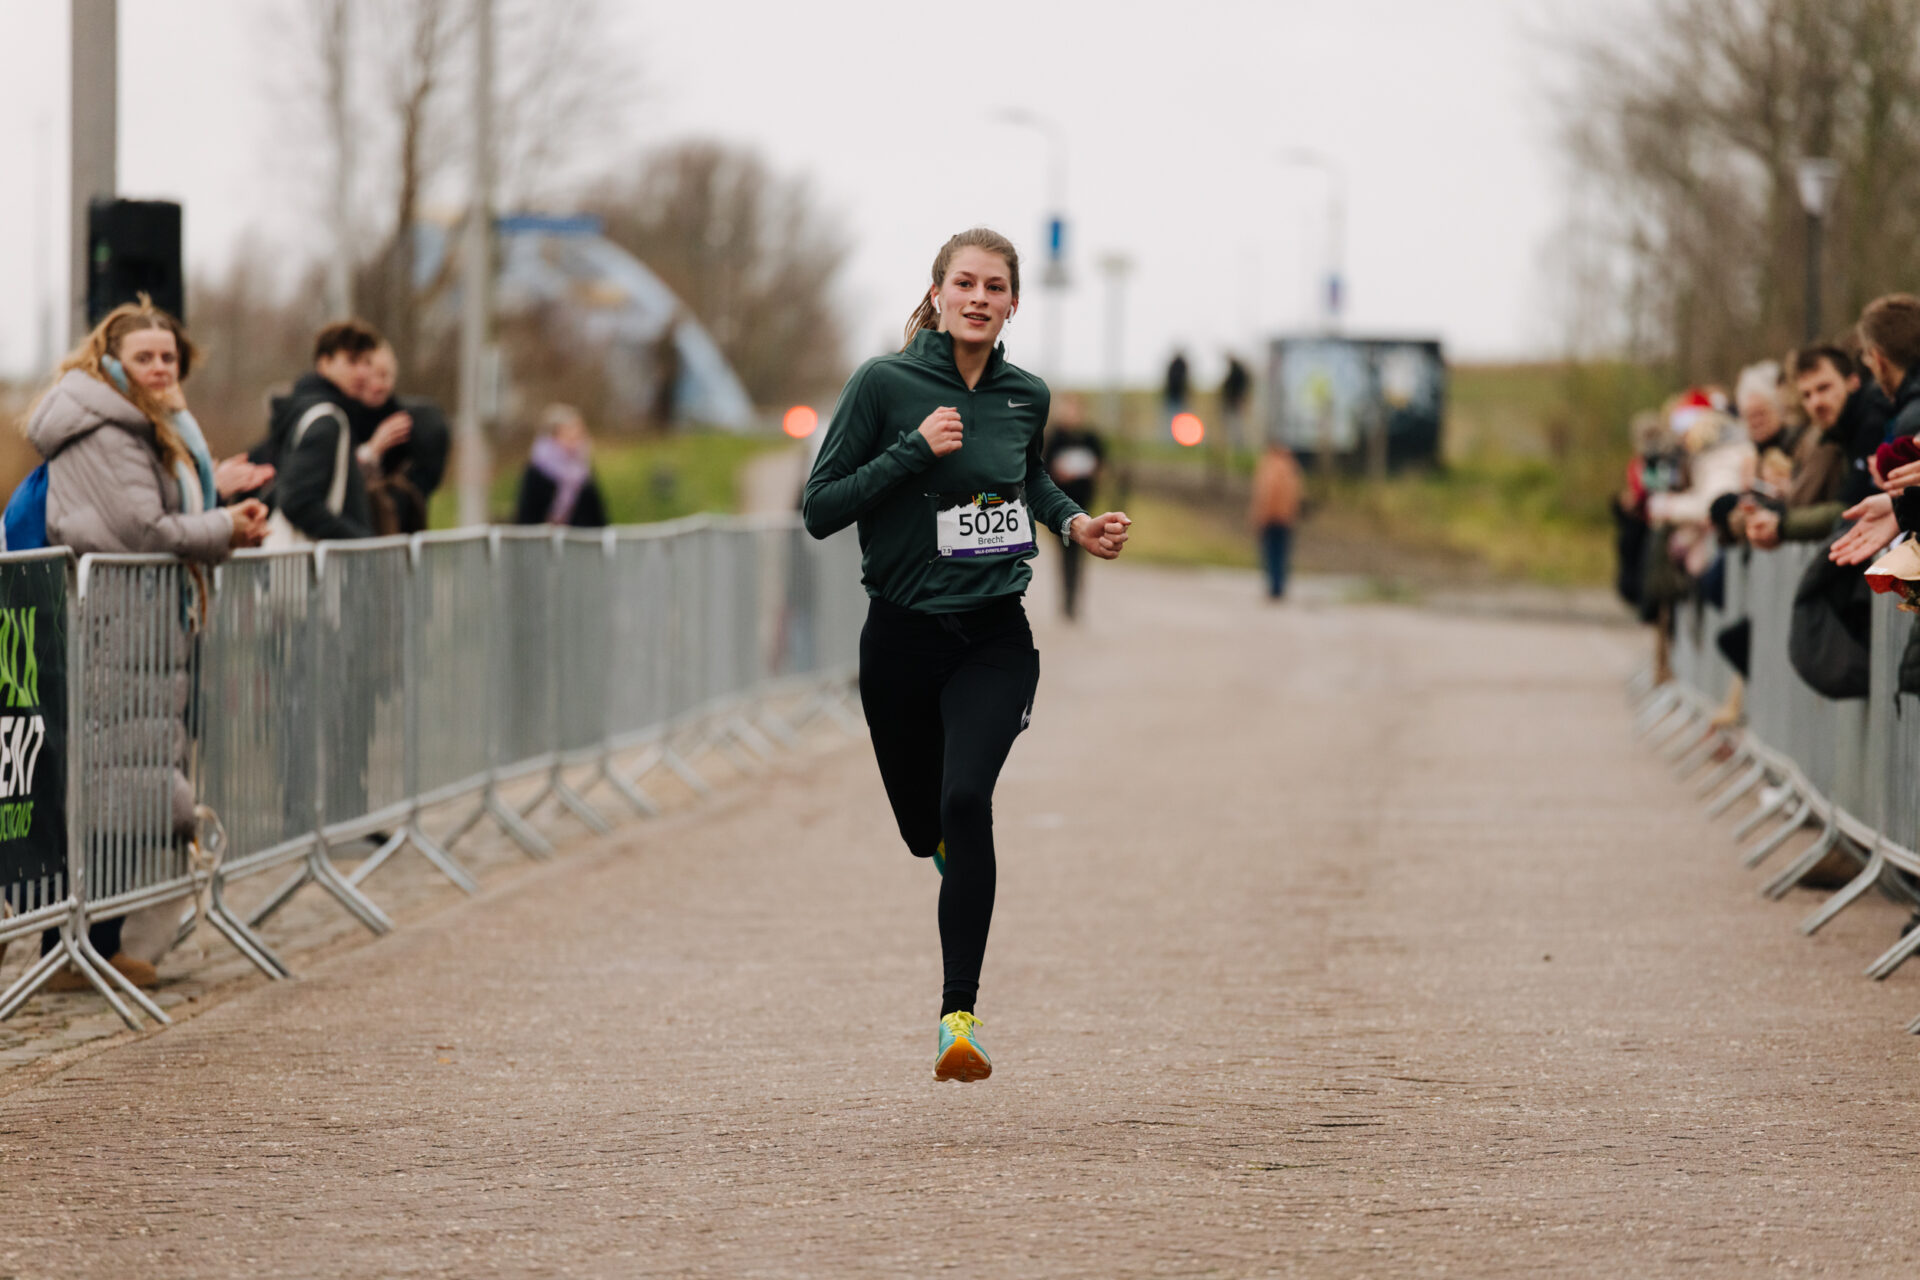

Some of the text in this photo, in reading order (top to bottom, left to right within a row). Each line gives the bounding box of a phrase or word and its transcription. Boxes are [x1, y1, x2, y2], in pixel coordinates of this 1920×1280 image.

[959, 509, 1019, 536] 5026
[978, 535, 1004, 545] Brecht
[0, 714, 46, 798] ENT
